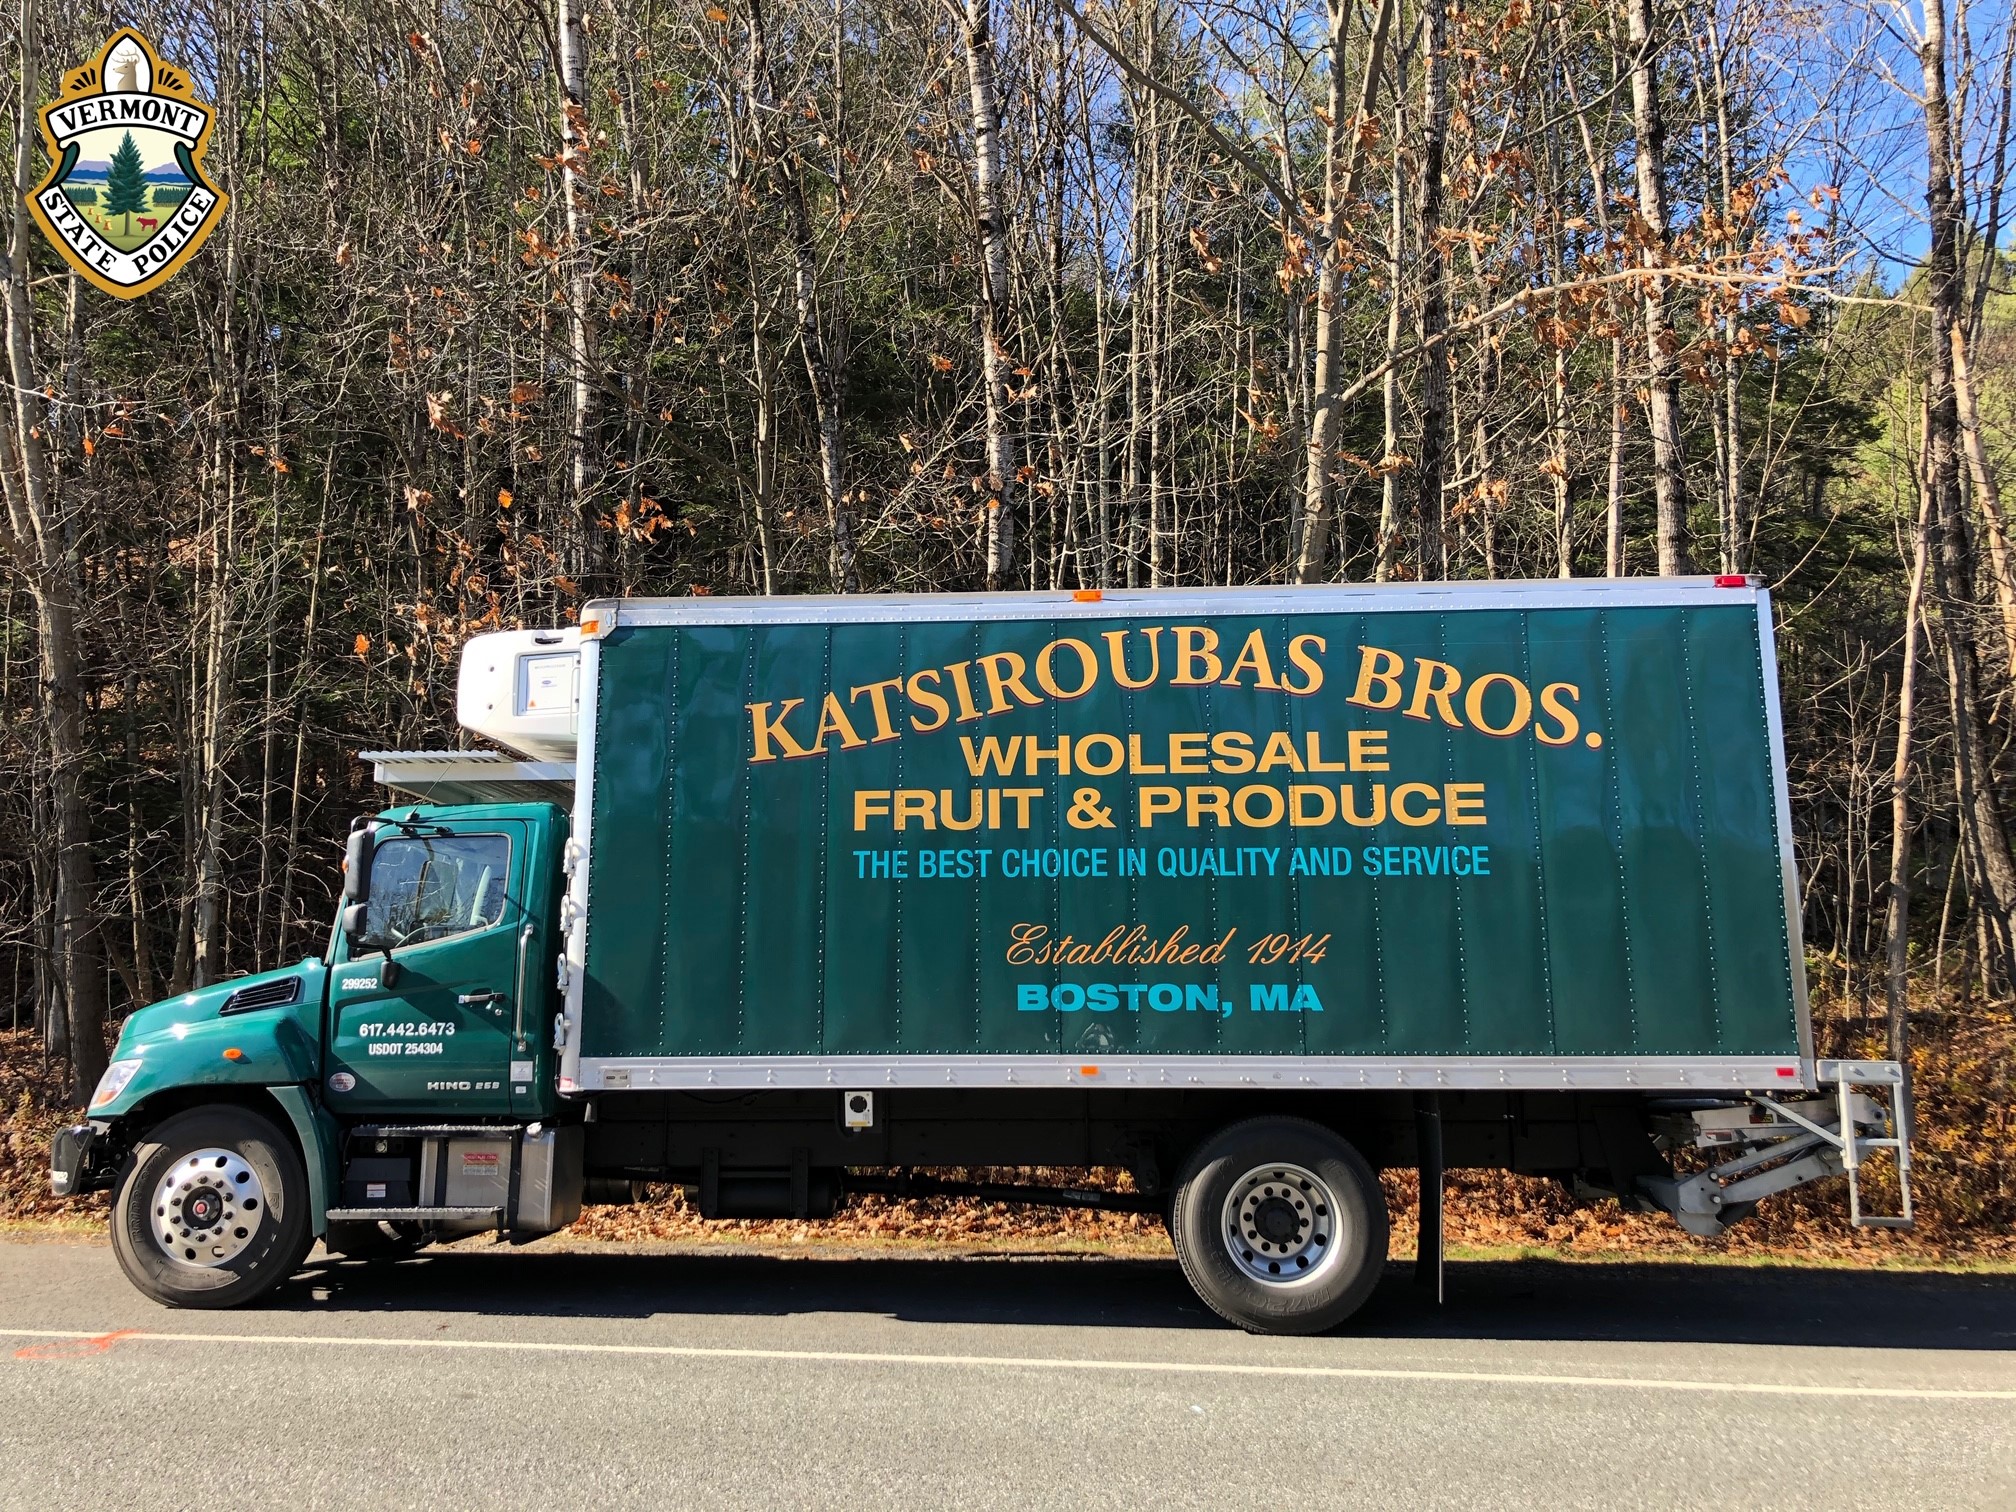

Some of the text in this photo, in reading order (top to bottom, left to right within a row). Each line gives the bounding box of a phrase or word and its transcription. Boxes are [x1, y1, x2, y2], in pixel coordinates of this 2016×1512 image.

[745, 626, 1603, 763] KATSIROUBAS BROS.
[959, 731, 1390, 776] WHOLESALE
[853, 782, 1487, 831] FRUIT & PRODUCE
[853, 845, 1490, 879] THE BEST CHOICE IN QUALITY AND SERVICE
[1006, 923, 1331, 965] Established 1914
[342, 978, 377, 990] 299252
[1017, 984, 1324, 1018] BOSTON, MA
[359, 1022, 455, 1037] 617.442.6473
[368, 1042, 443, 1055] USDOT 254304
[427, 1081, 471, 1090] HINO
